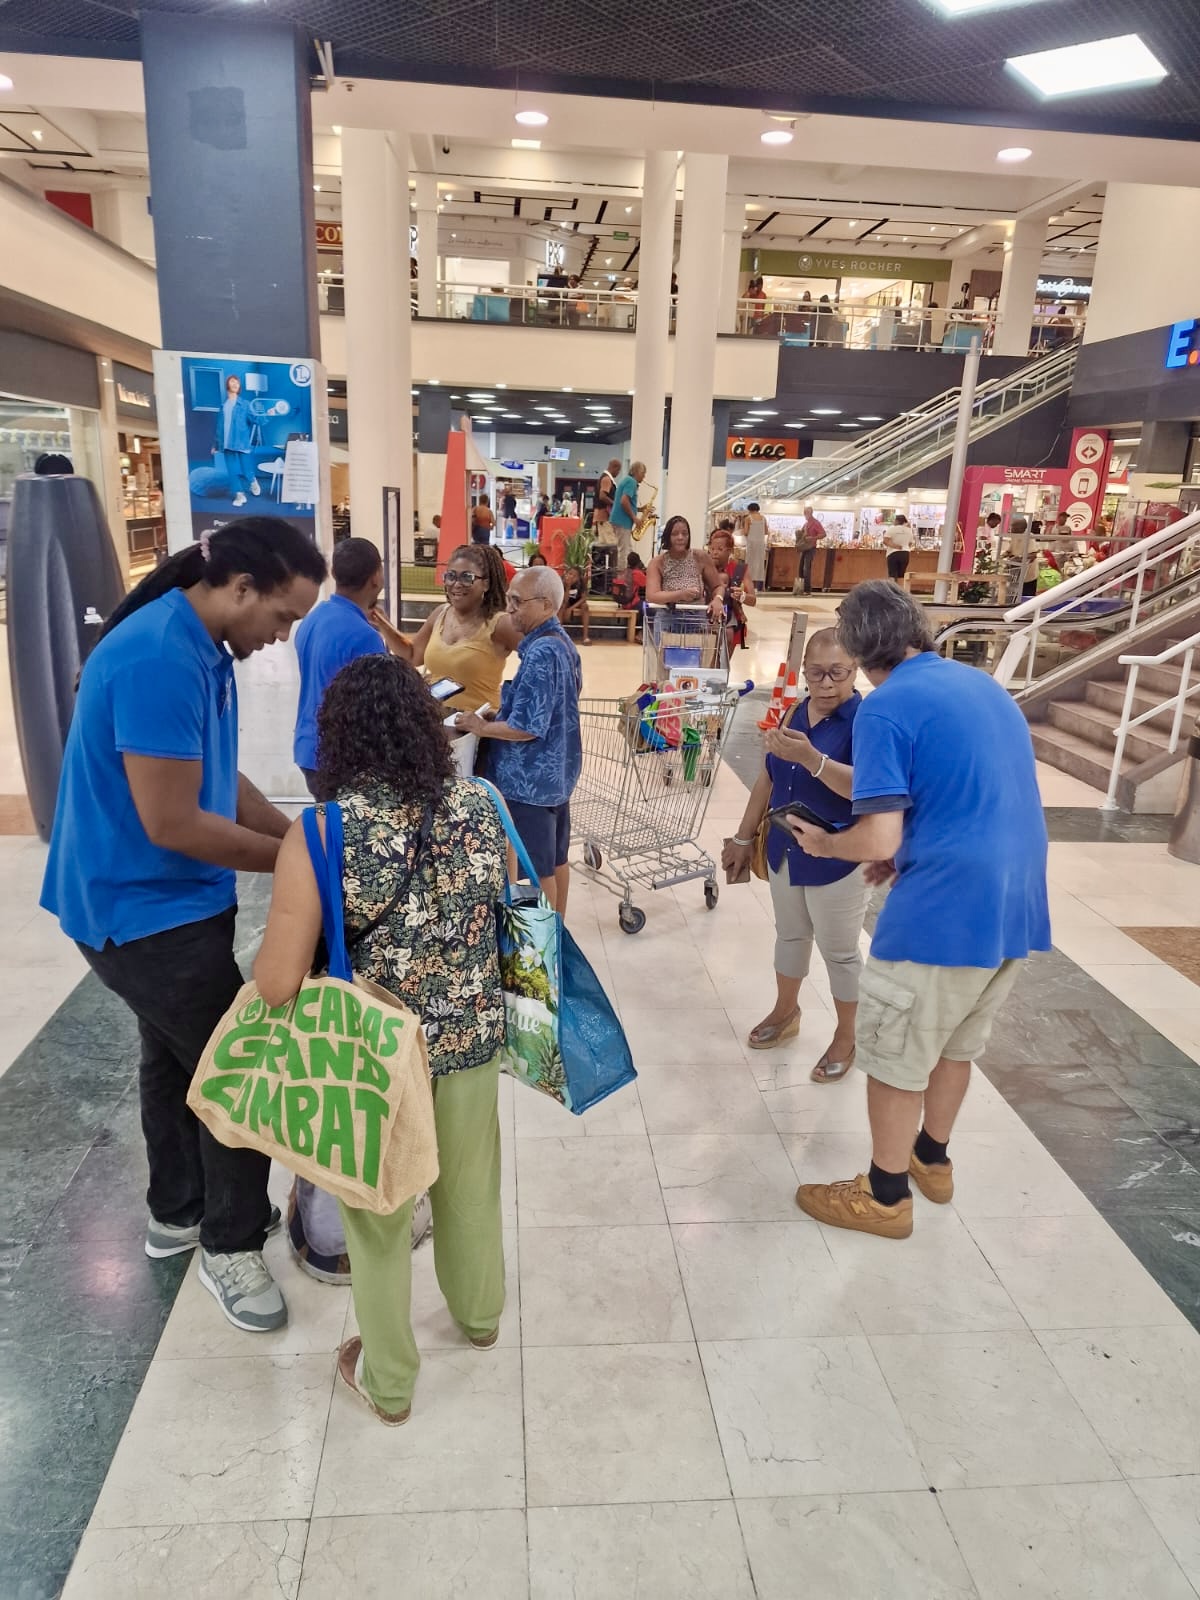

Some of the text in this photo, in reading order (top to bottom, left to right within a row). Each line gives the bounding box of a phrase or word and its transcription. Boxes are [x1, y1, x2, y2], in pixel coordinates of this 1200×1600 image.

[815, 258, 902, 273] YVES ROCHER
[1004, 468, 1047, 479] SMART
[294, 985, 405, 1058] CABAS
[213, 1022, 391, 1094] GRAND
